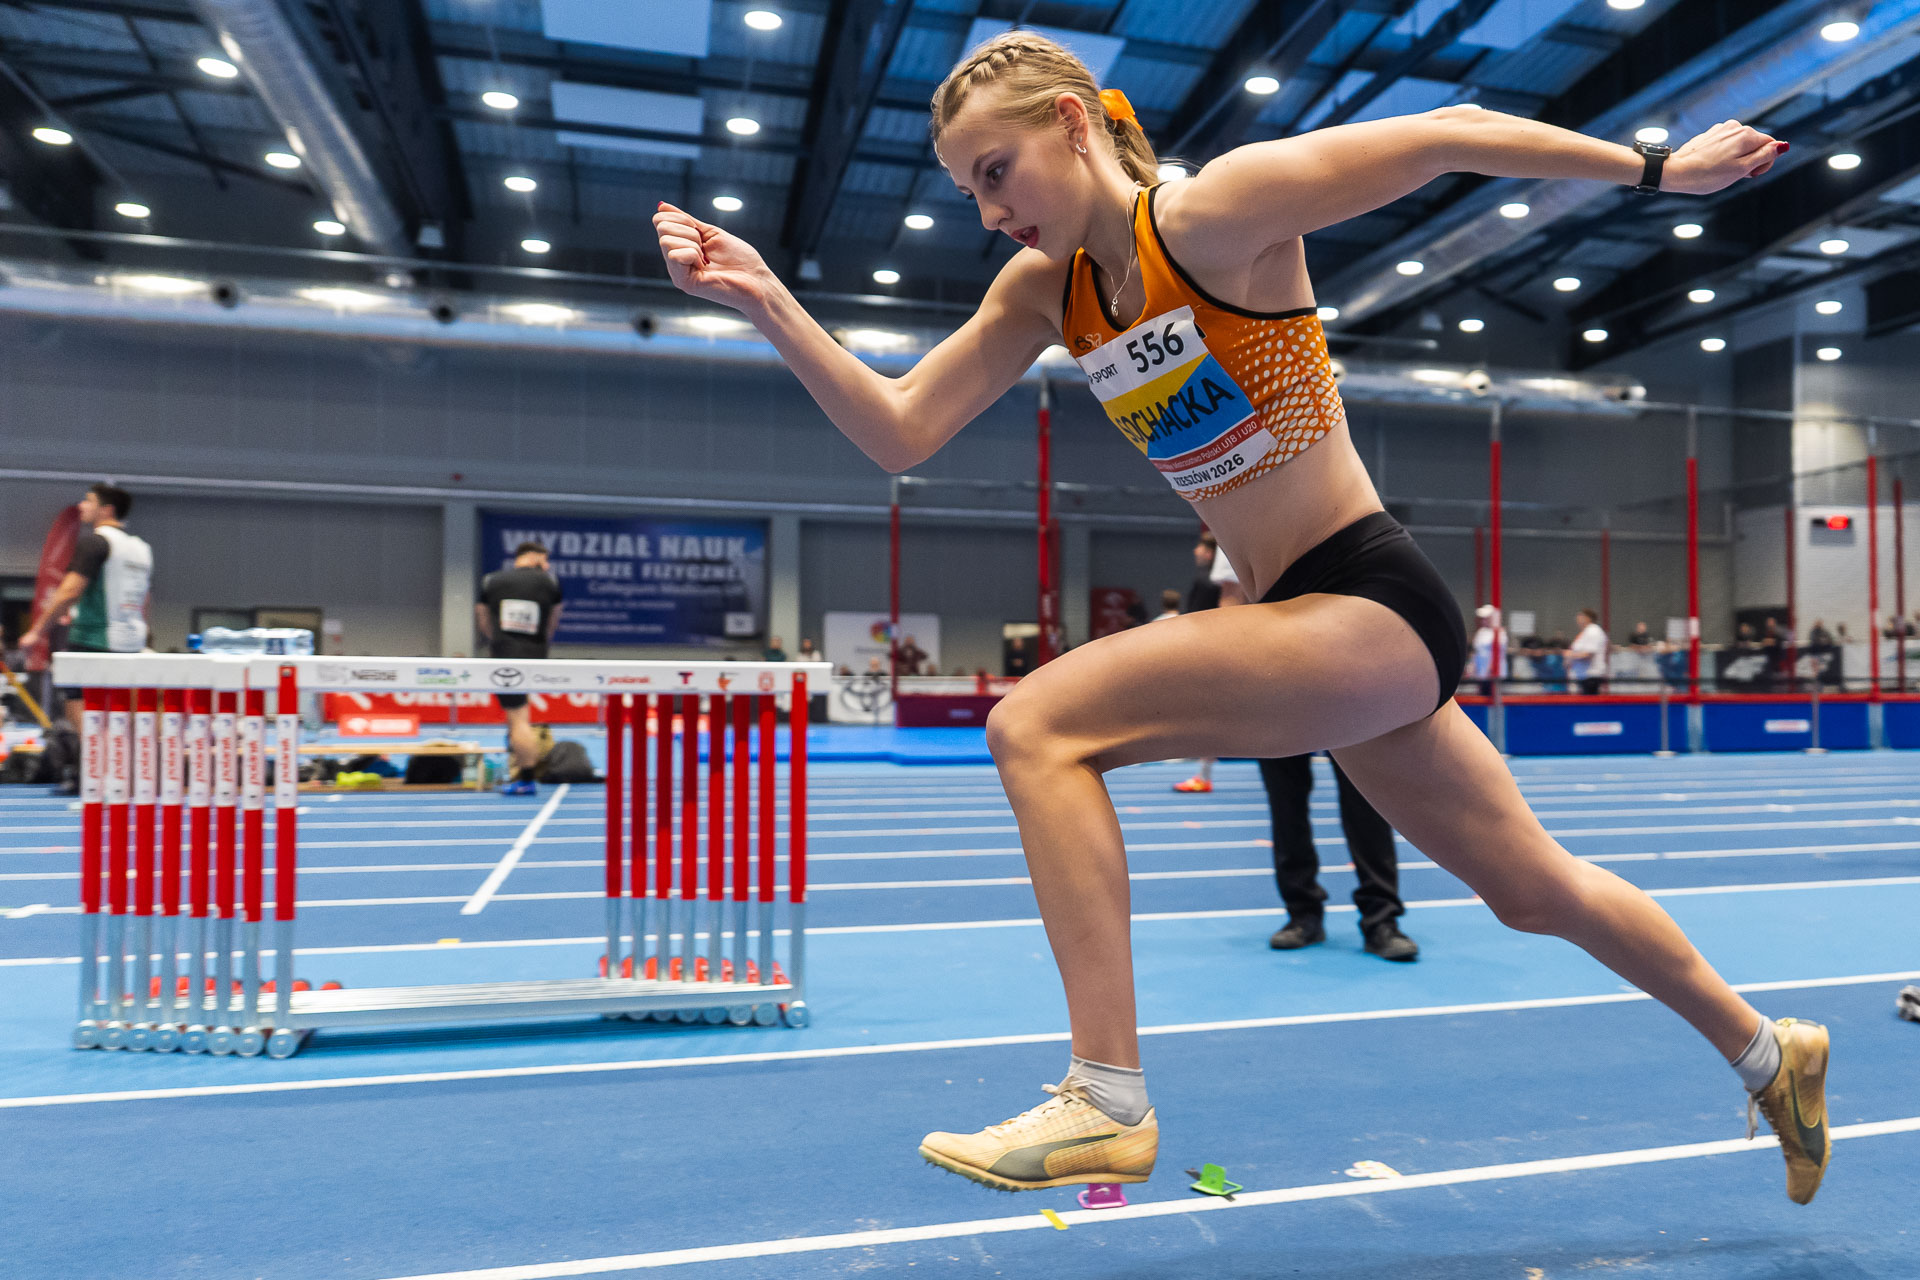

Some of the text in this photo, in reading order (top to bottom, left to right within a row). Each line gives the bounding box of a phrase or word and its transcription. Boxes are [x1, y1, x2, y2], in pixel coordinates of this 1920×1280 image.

[1125, 322, 1185, 374] 556
[1092, 363, 1119, 384] SPORT
[1114, 377, 1235, 444] SOCHACKA
[1201, 445, 1223, 462] Polski
[1221, 433, 1238, 450] U18
[1242, 420, 1258, 436] U20
[1173, 453, 1245, 488] RZESZÓW 2026
[658, 534, 747, 560] NAUK
